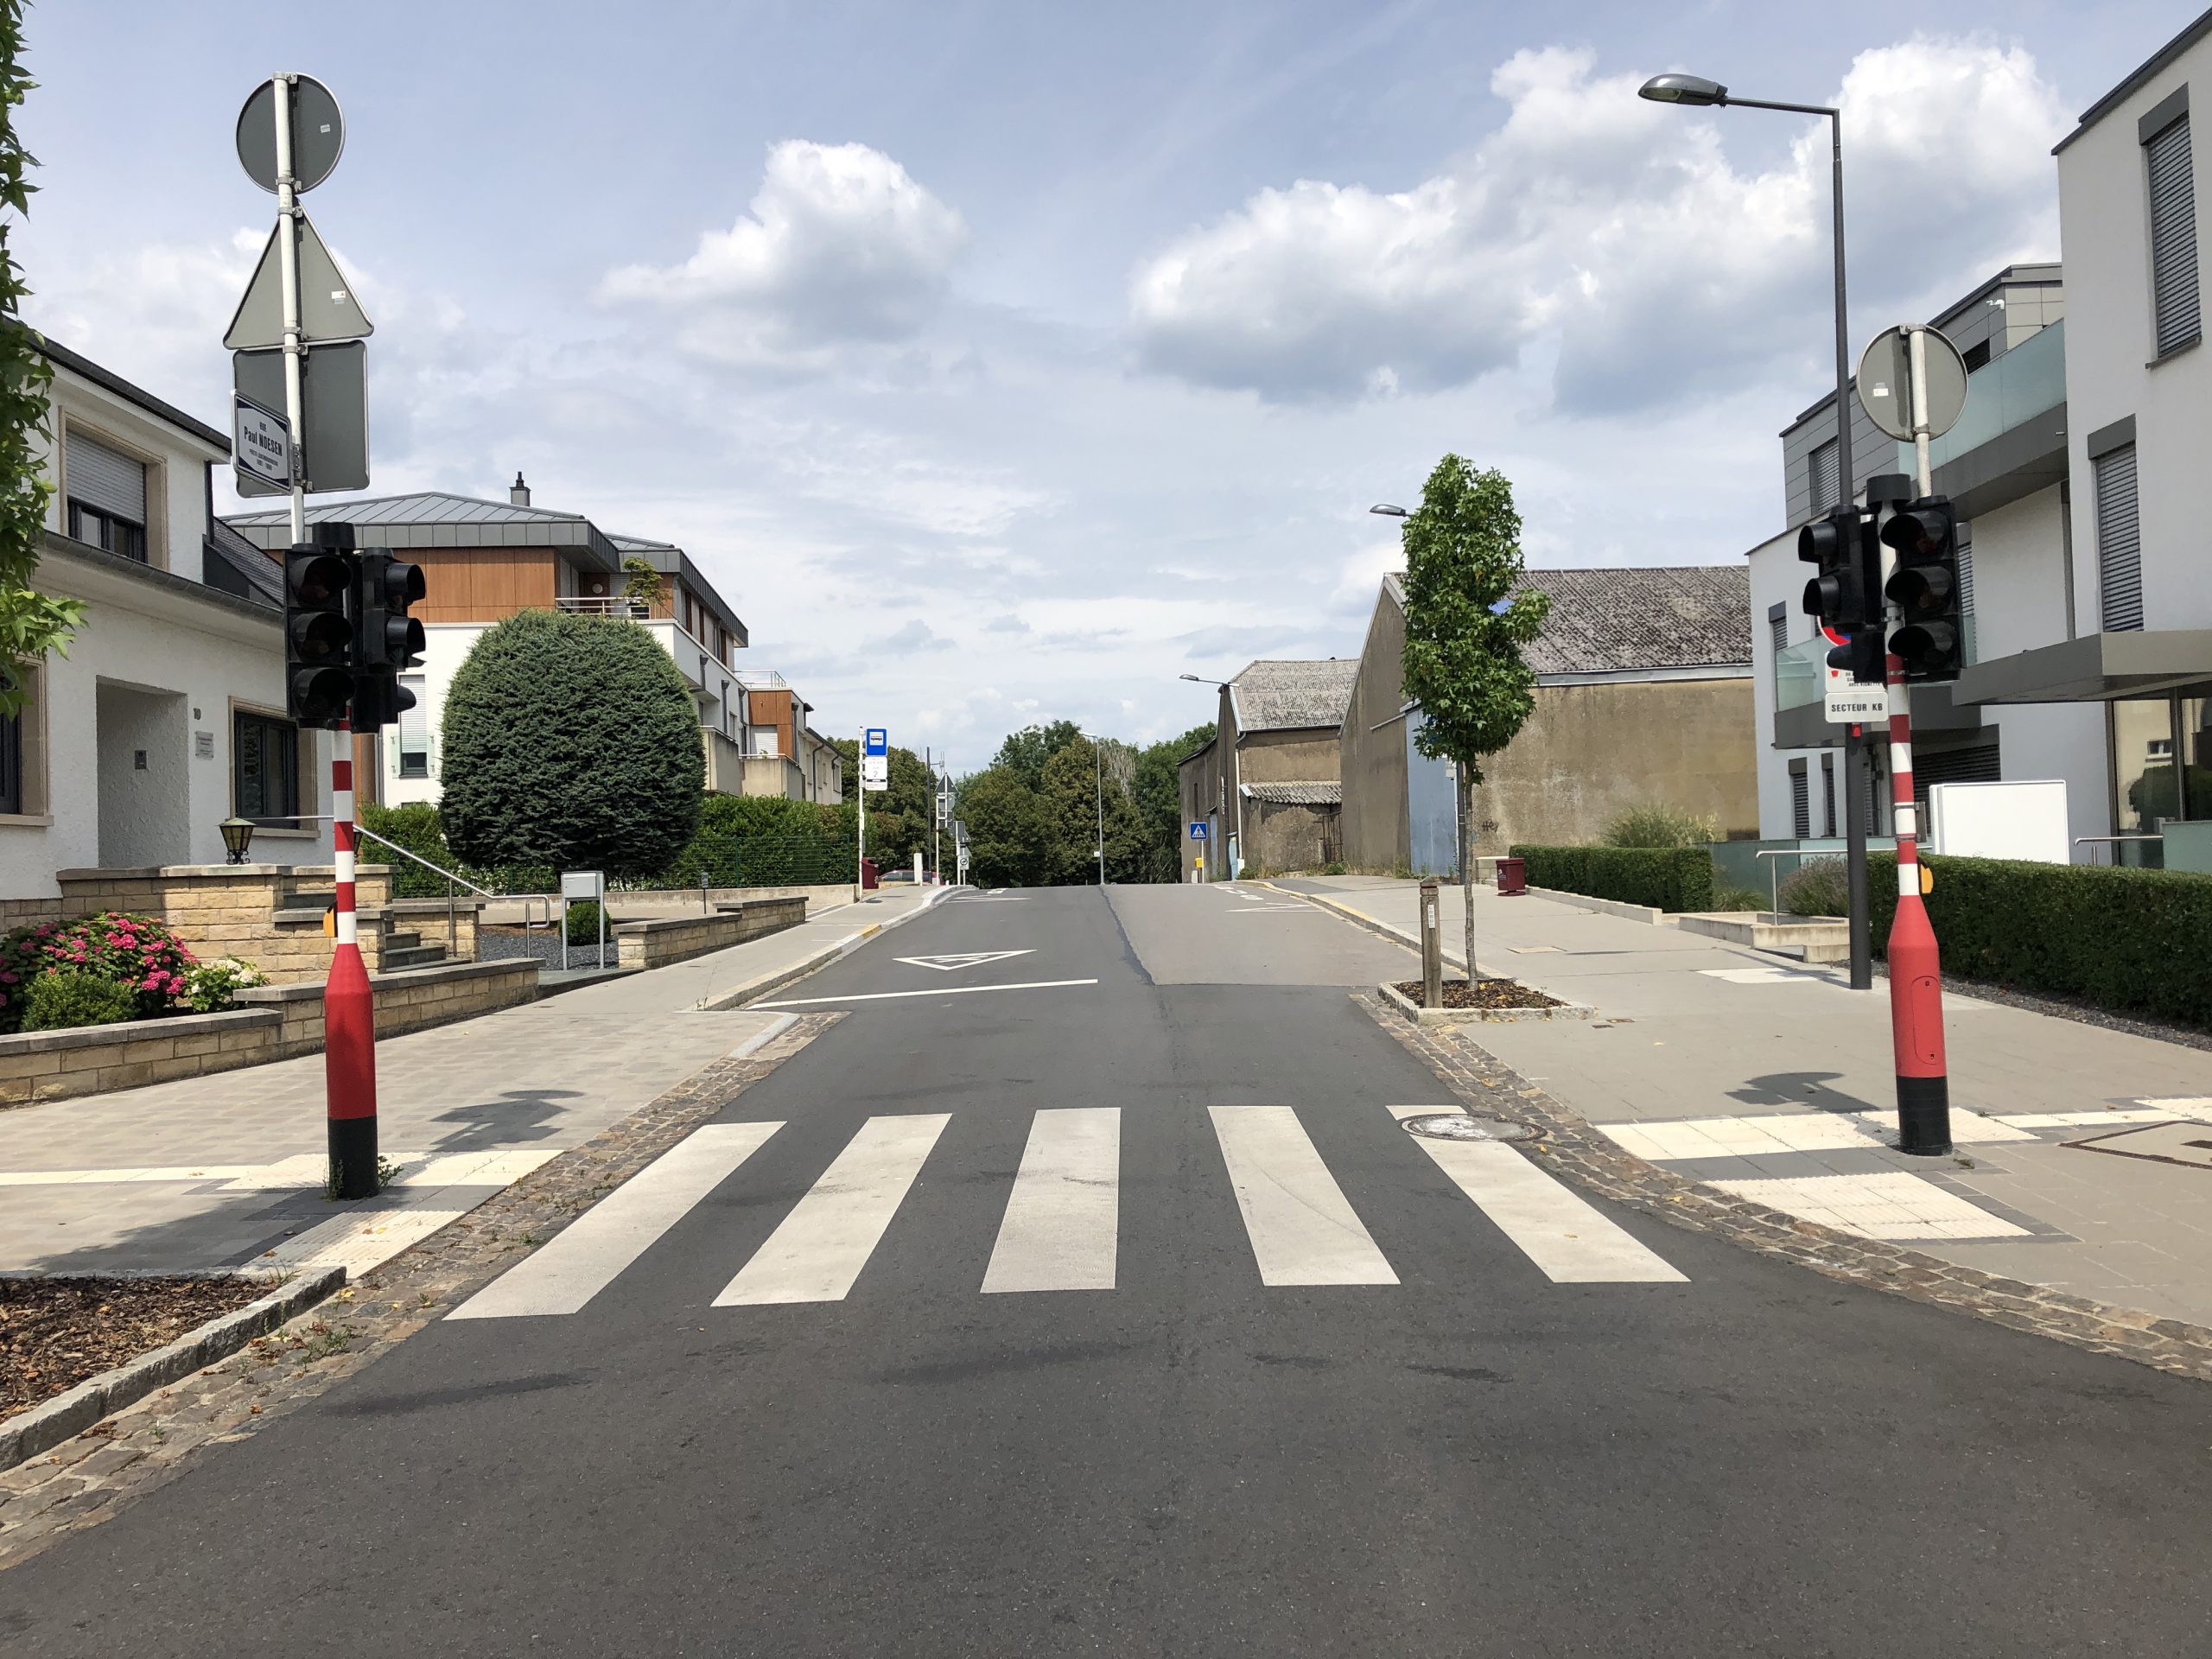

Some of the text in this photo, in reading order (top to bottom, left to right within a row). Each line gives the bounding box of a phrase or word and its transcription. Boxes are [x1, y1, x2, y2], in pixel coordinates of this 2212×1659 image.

[244, 425, 283, 456] Paul NOESEN
[1831, 702, 1883, 712] SECTEUR KB
